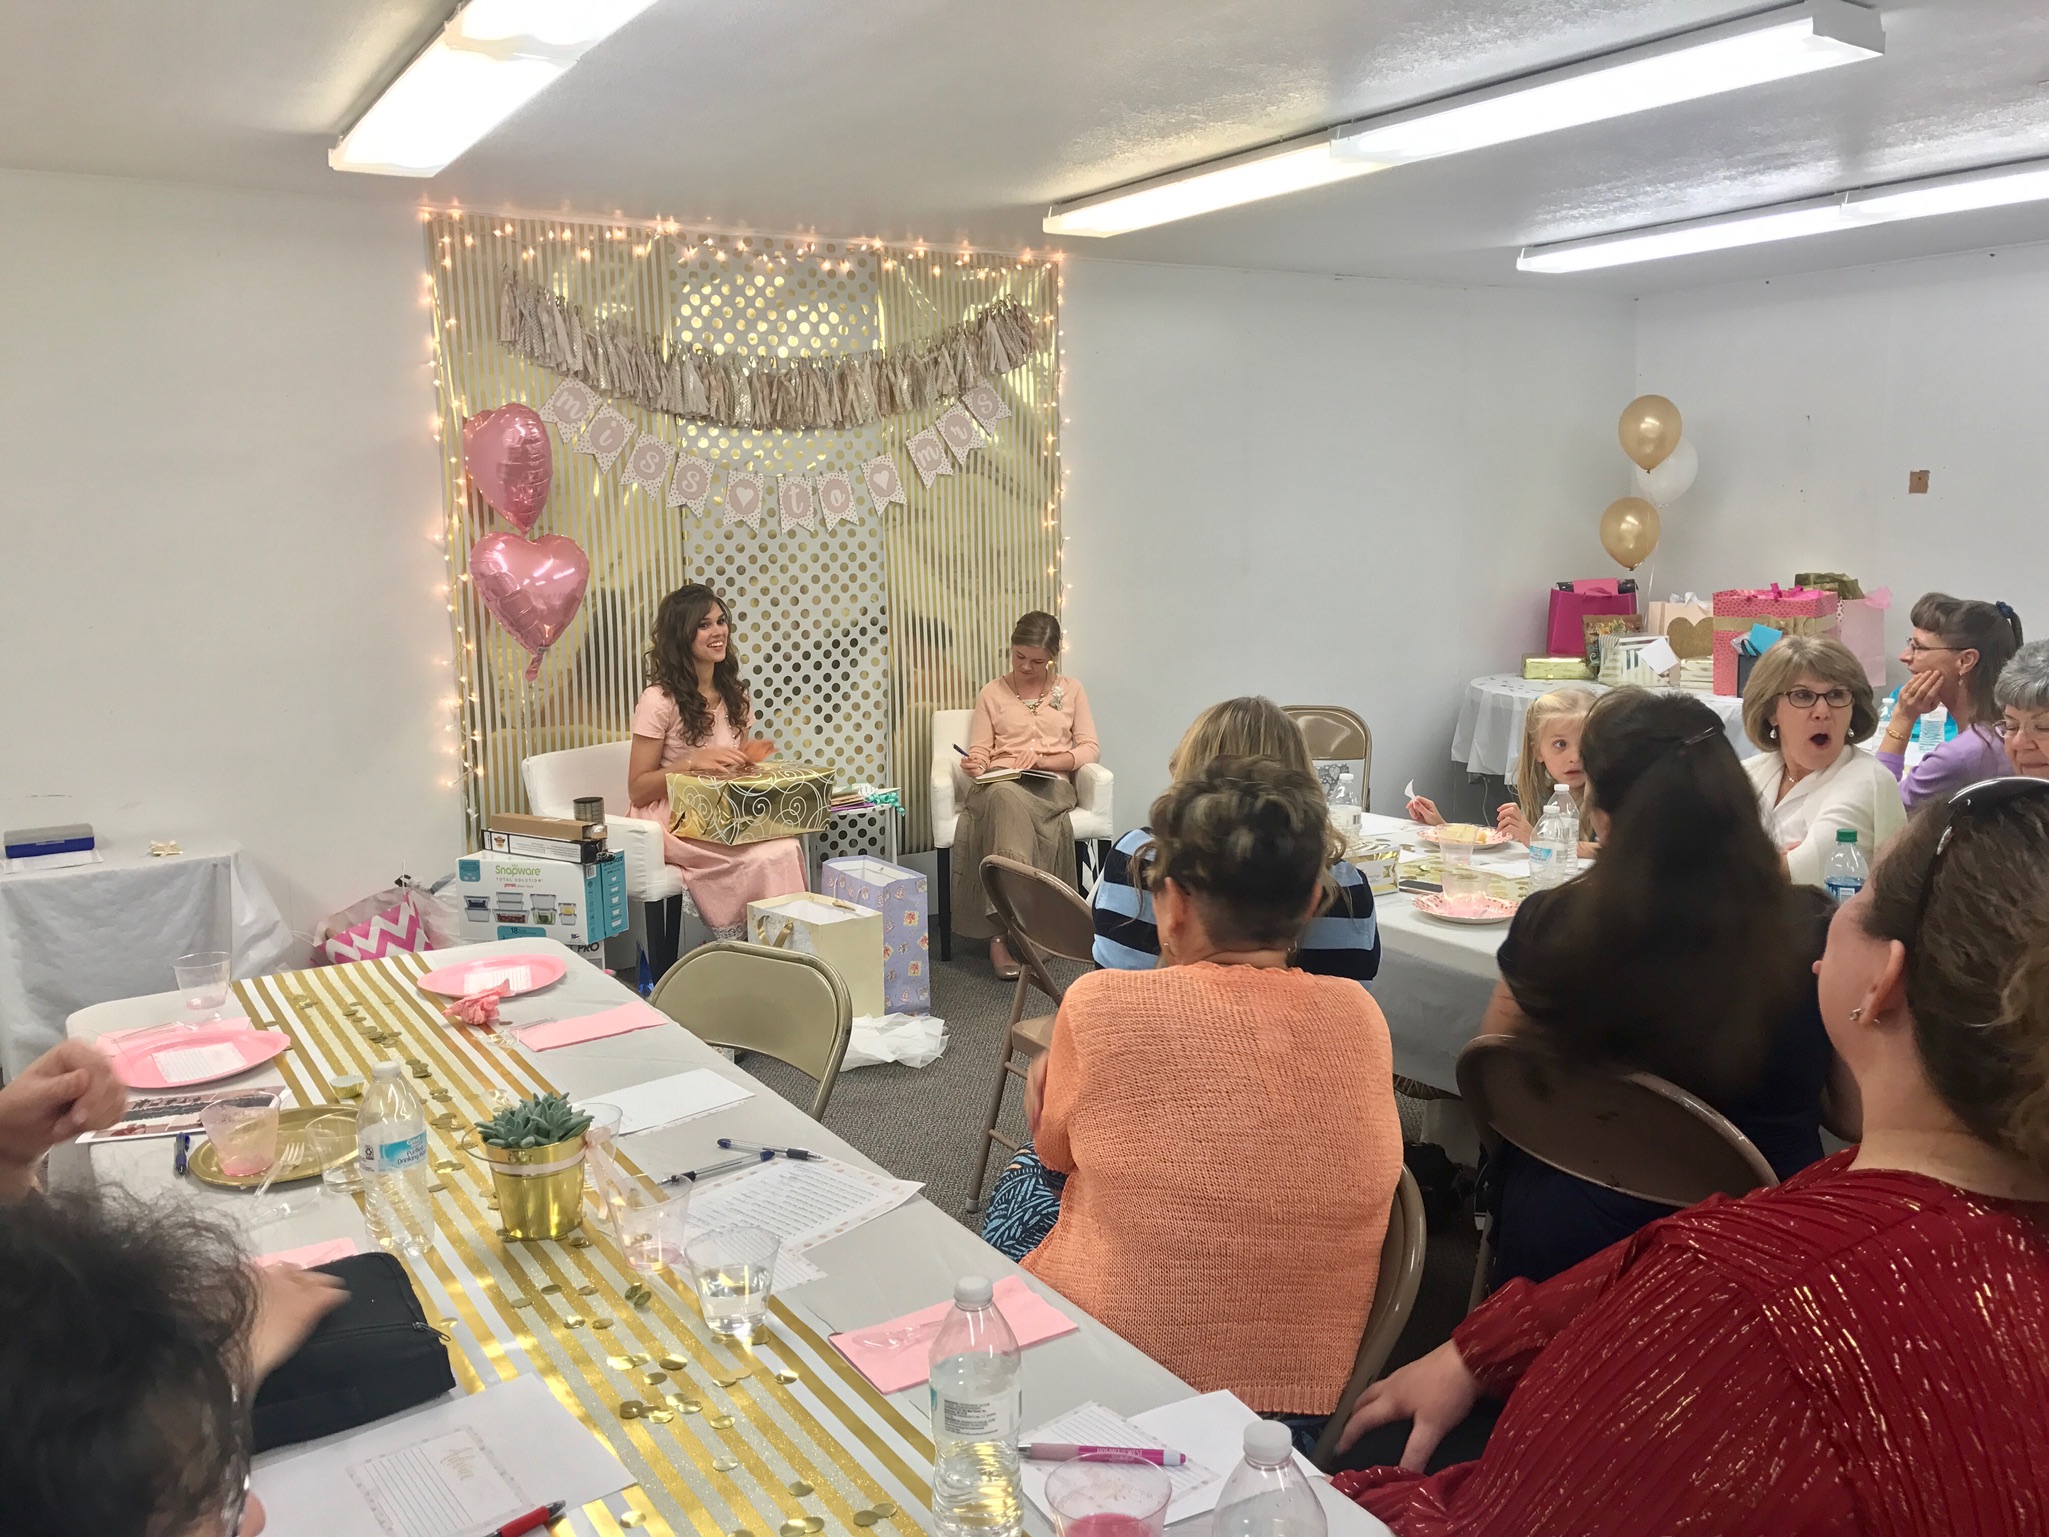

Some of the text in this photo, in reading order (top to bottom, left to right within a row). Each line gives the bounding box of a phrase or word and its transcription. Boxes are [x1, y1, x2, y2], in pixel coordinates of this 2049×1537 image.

[788, 485, 846, 514] to
[917, 393, 994, 468] mrs
[495, 864, 541, 877] Snapware
[577, 942, 600, 953] PRO
